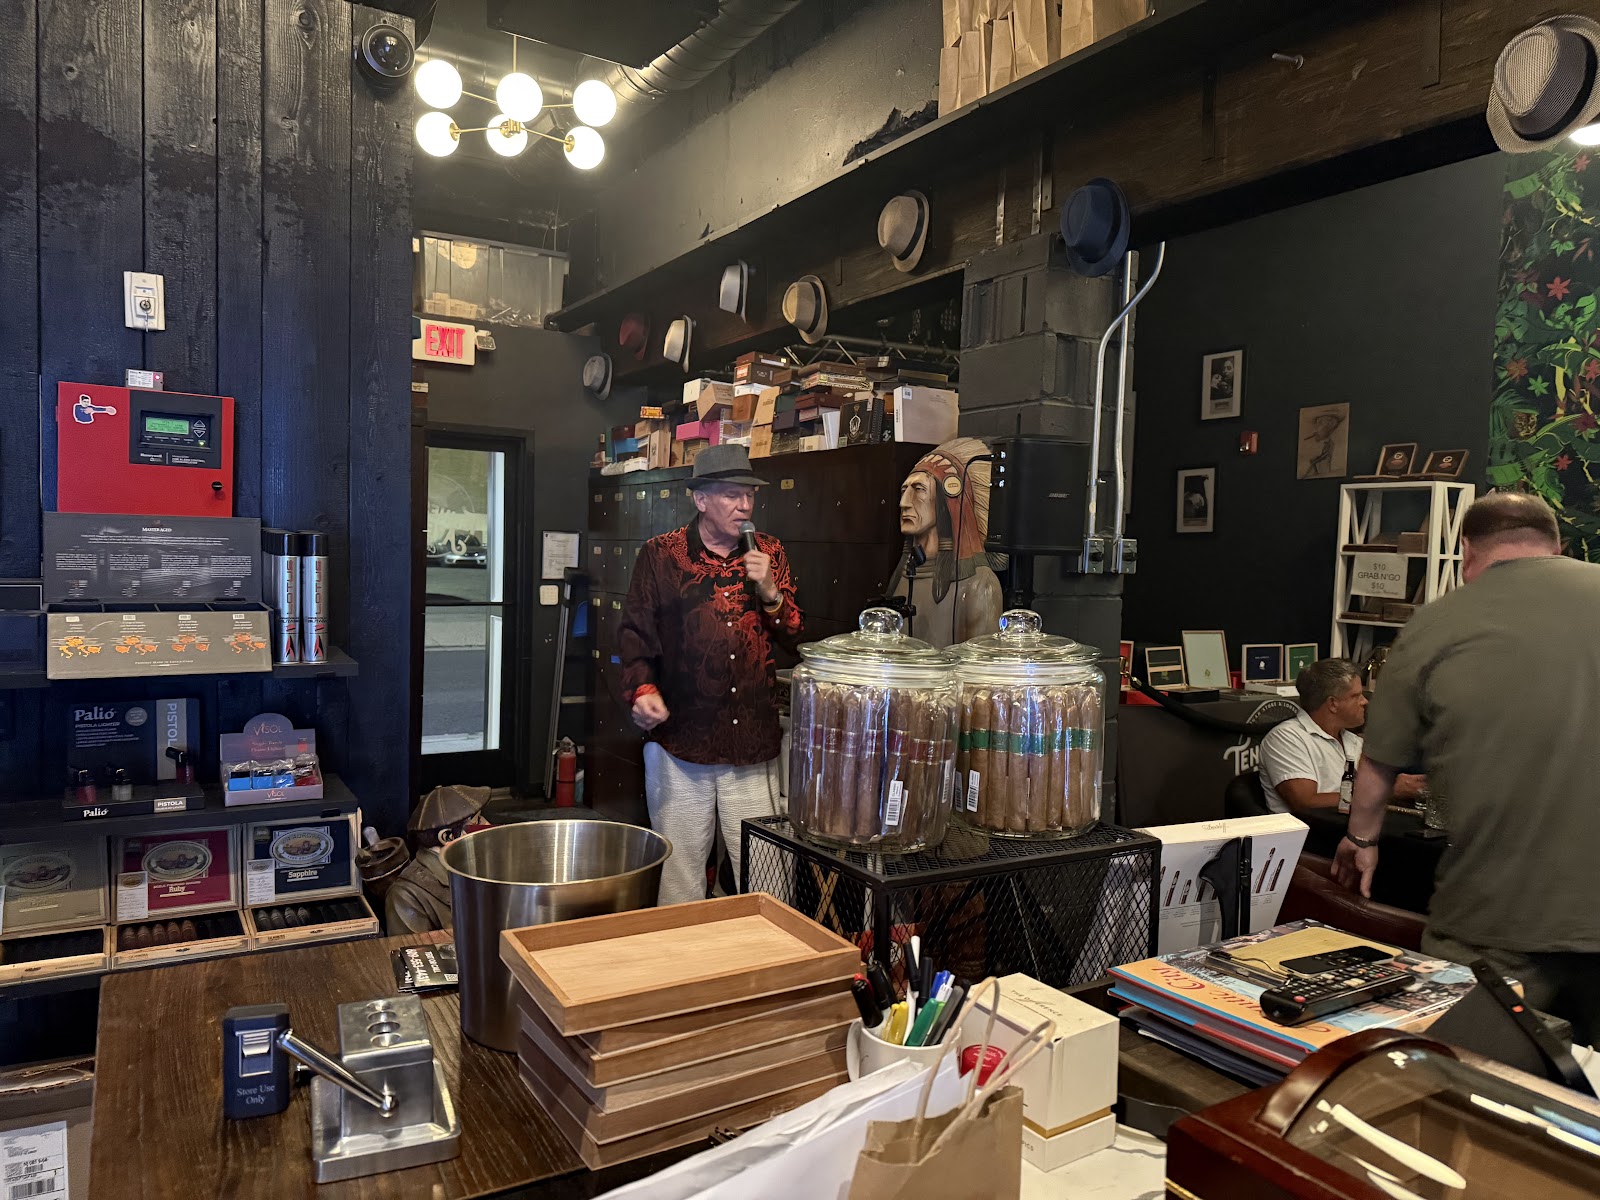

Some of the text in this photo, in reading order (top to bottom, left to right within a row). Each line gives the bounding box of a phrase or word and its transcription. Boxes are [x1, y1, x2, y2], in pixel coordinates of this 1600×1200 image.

[425, 324, 466, 359] EXIT
[1373, 563, 1386, 571] $10
[1357, 571, 1379, 580] GRAB
[286, 559, 294, 615] LOTUS
[315, 559, 323, 615] LOTUS
[1371, 582, 1385, 590] $10
[74, 706, 116, 721] Palió
[1283, 702, 1298, 714] LOUNG
[167, 703, 178, 748] PISTOL
[83, 807, 109, 818] Palió
[288, 869, 318, 879] Sapphire
[168, 886, 186, 894] Ruby
[237, 1084, 276, 1096] Store Use
[245, 1094, 265, 1105] Only
